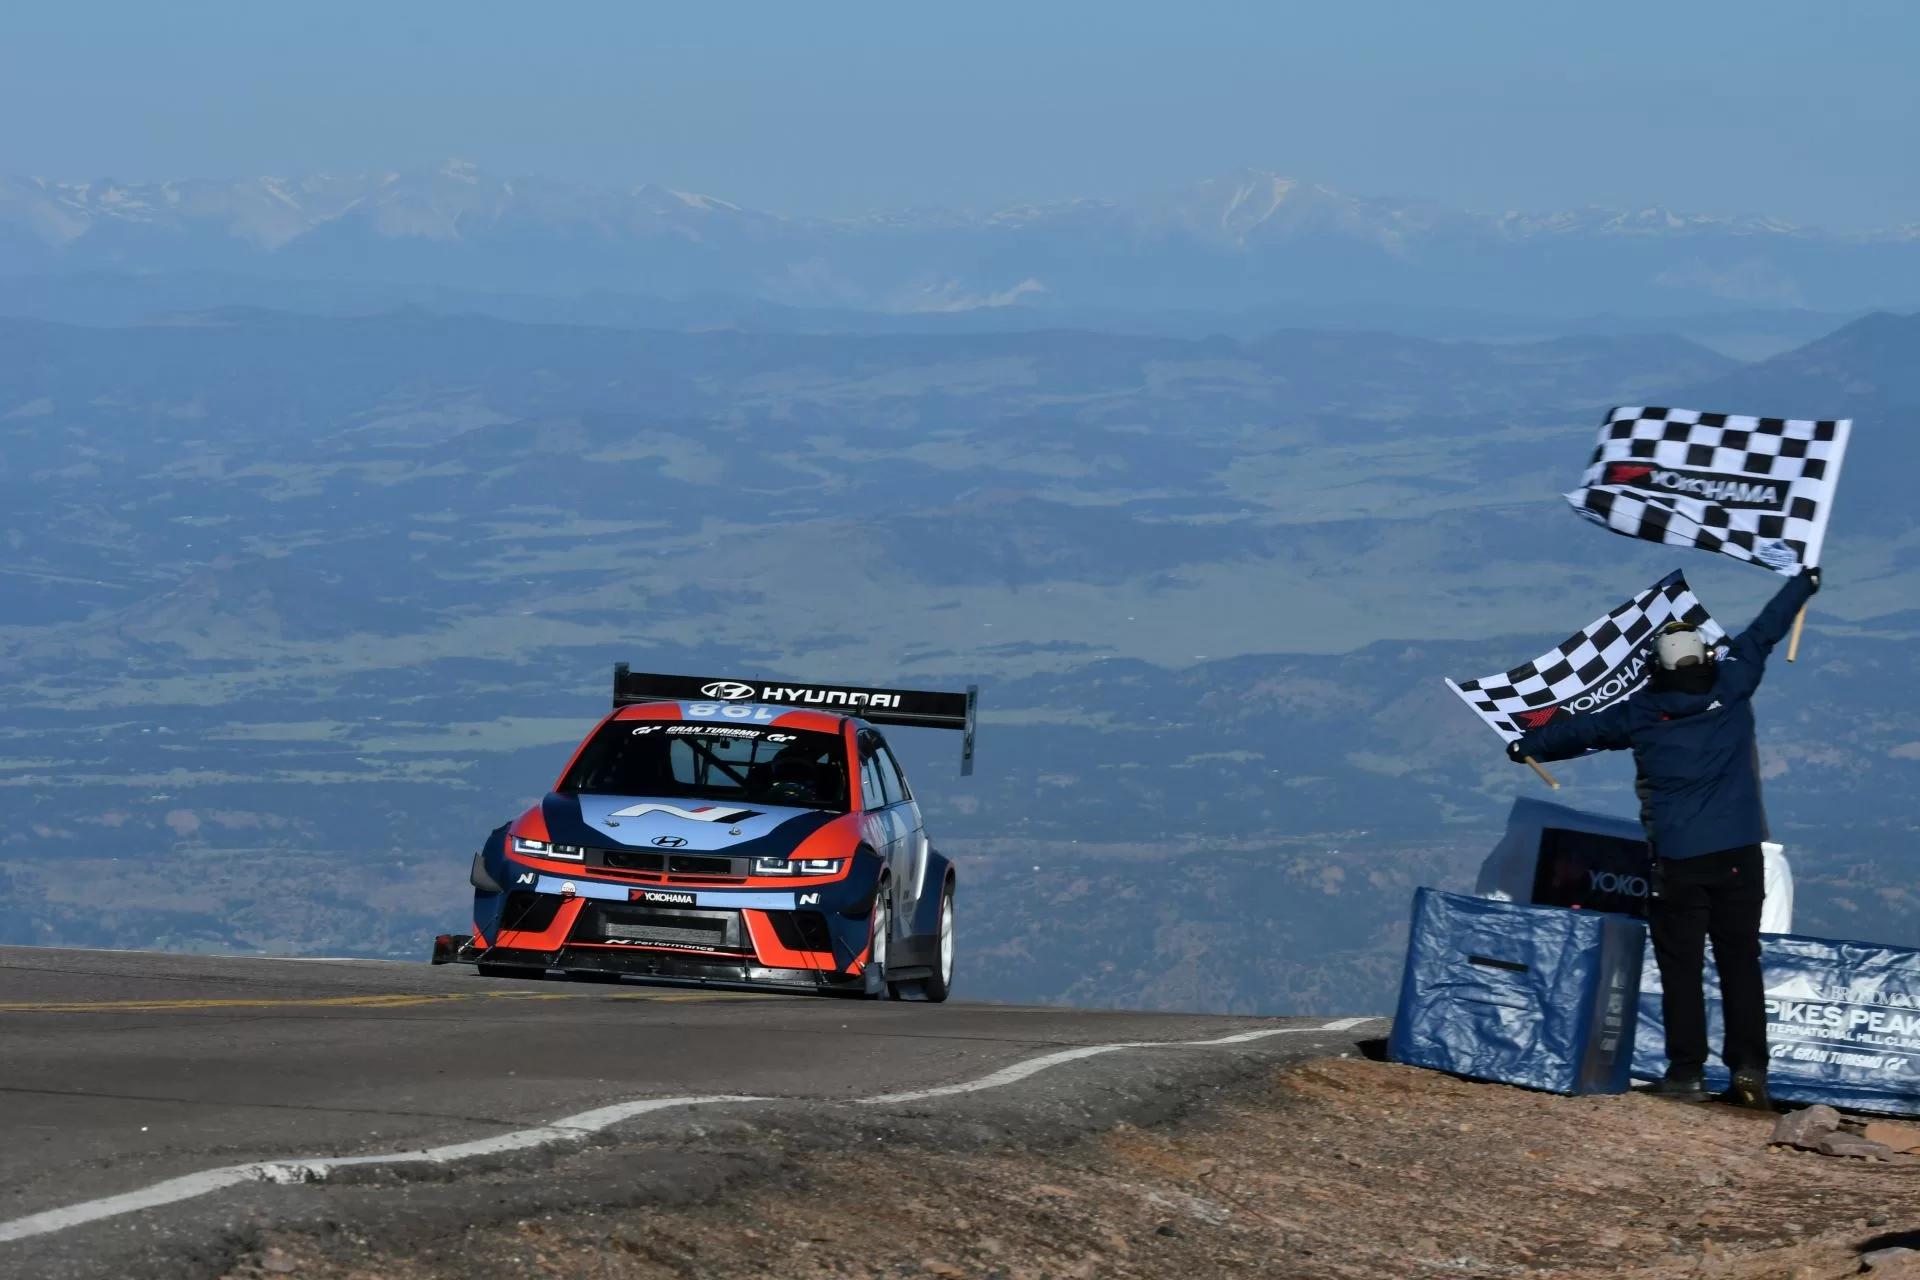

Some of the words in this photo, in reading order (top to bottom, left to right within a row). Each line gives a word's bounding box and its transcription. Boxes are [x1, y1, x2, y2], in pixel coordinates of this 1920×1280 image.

[1650, 470, 1777, 503] YOKOHAMA
[762, 687, 900, 707] HYUNDAI
[666, 726, 703, 734] GRAN
[706, 727, 761, 737] TURISMO
[644, 892, 693, 904] YOKOHAMA
[634, 940, 715, 952] Performance
[1793, 1047, 1829, 1062] GRAN
[1829, 1052, 1884, 1069] TURISMO
